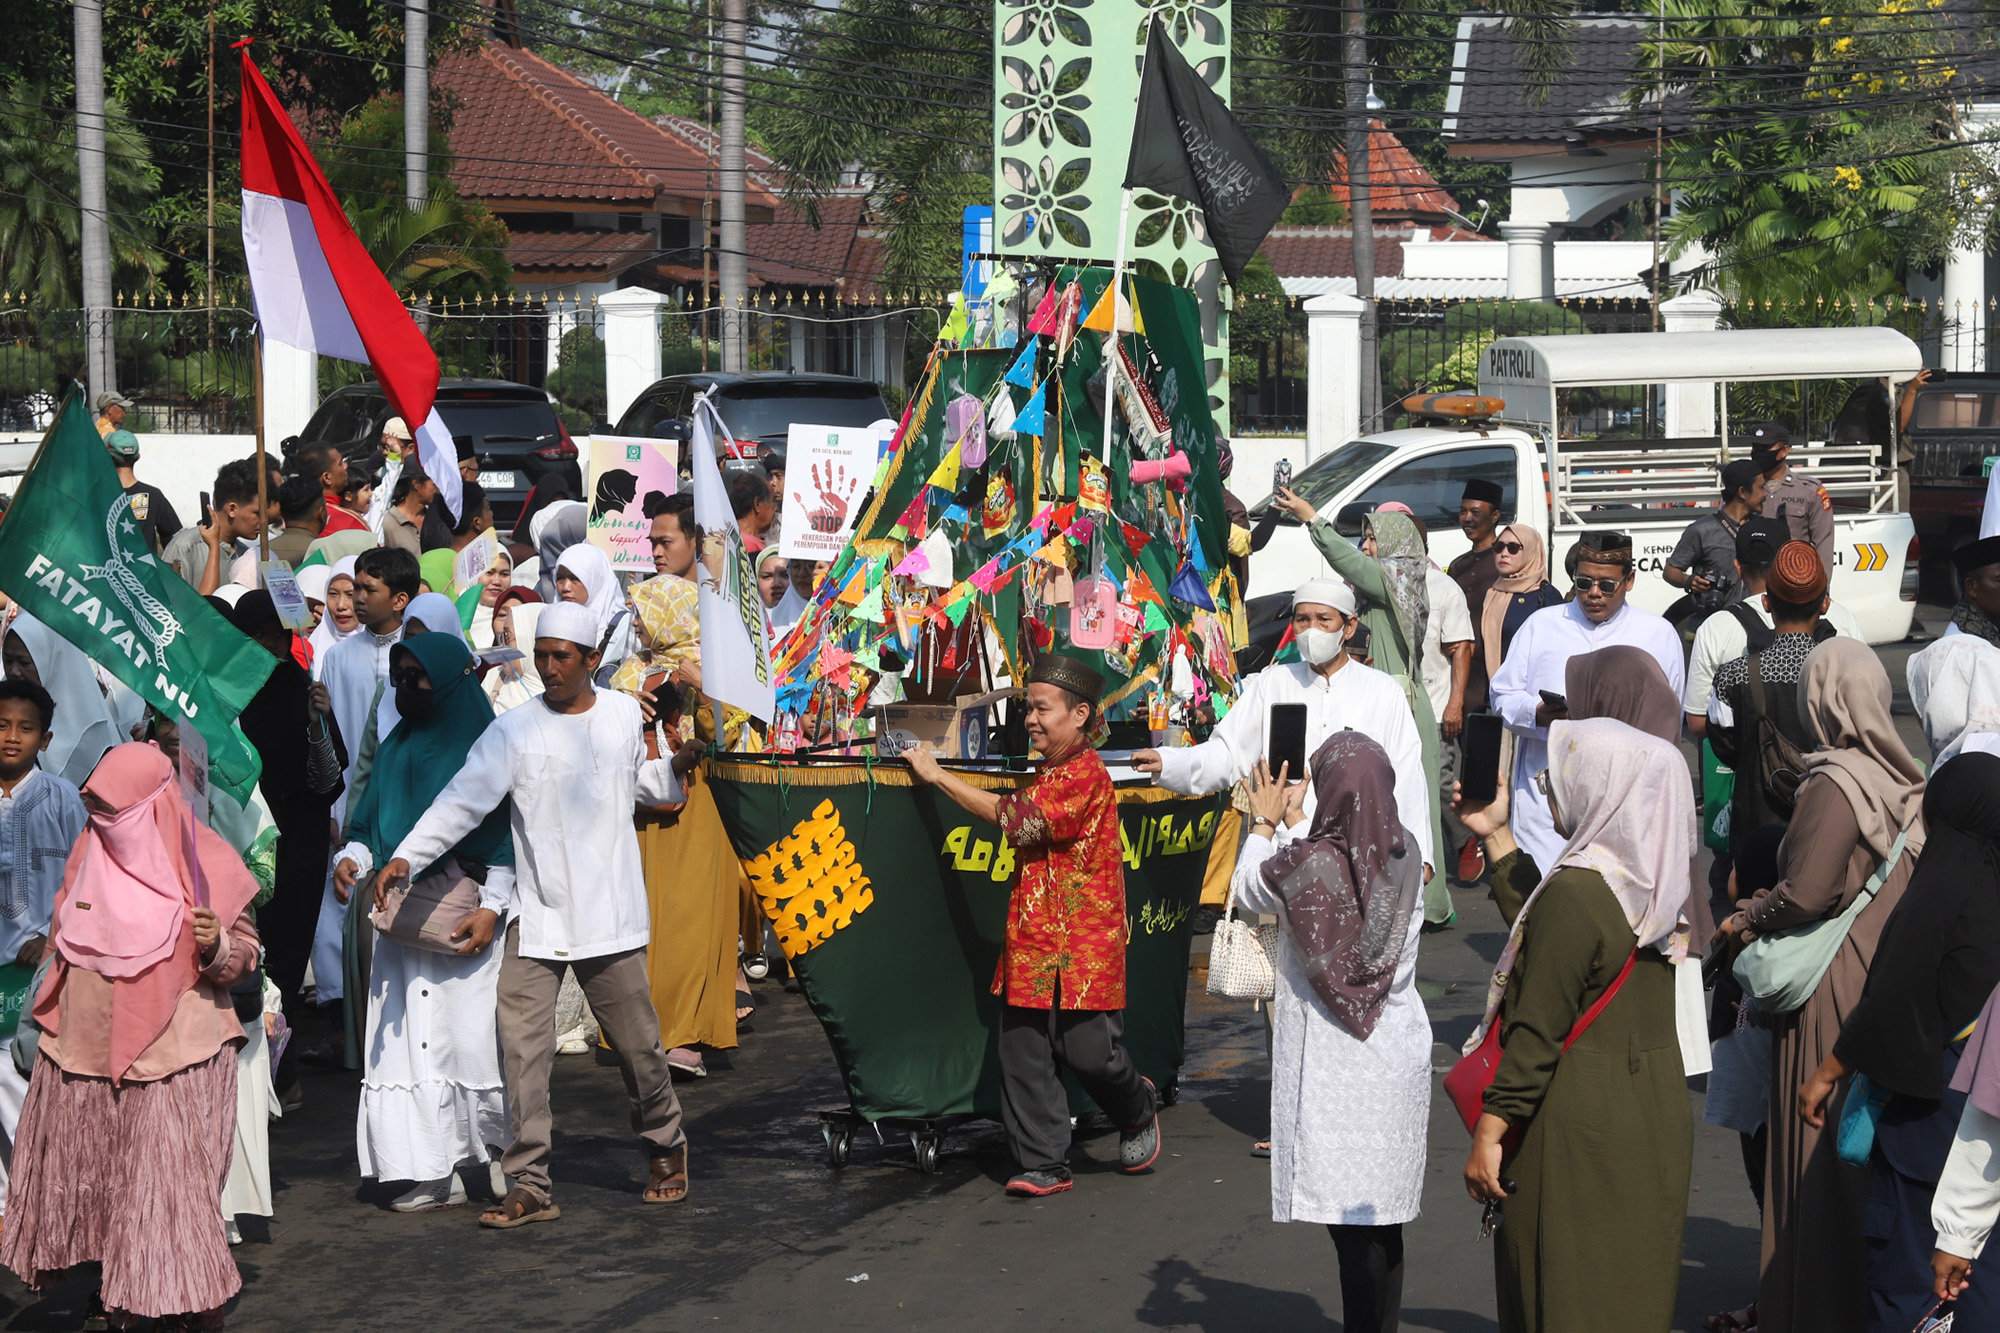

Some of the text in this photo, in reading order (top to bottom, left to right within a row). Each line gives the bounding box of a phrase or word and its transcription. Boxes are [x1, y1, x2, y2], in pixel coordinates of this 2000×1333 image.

[1490, 348, 1535, 379] PATROLI
[1781, 496, 1804, 504] POLRI
[588, 511, 649, 531] Woman
[811, 515, 843, 532] STOP
[609, 533, 642, 547] Support
[793, 540, 828, 550] PEREMPUAN
[801, 533, 834, 543] KEKERASAN
[25, 553, 199, 719] FATAYAT NU
